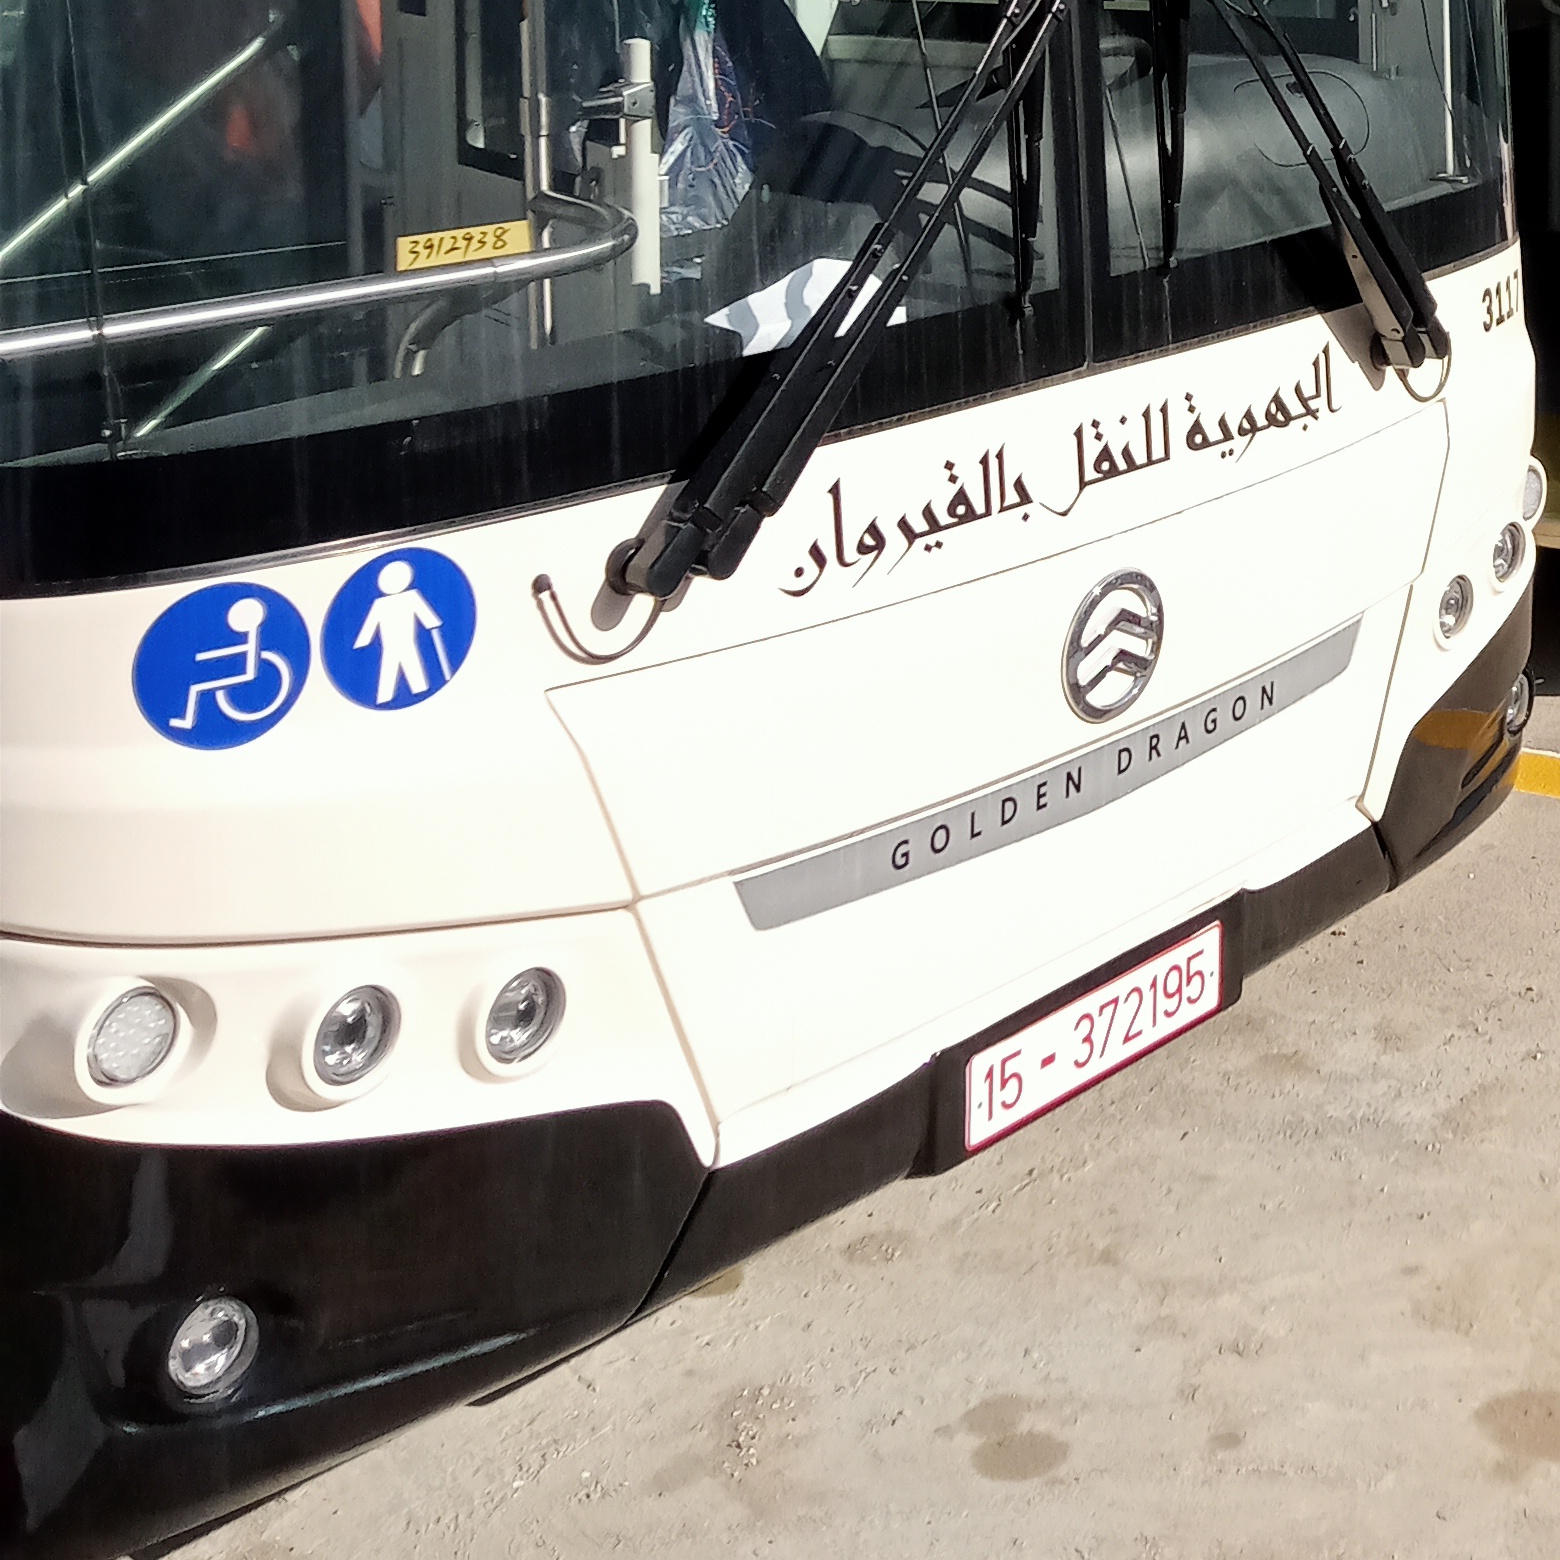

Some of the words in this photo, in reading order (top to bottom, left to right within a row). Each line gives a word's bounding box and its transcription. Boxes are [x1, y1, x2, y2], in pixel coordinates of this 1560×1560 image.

[408, 226, 511, 266] 3912938
[1482, 268, 1519, 332] 3117
[1040, 398, 1172, 517] للنقل
[1185, 341, 1342, 463] الجهوية
[778, 442, 1034, 597] بالقيروان
[891, 766, 1083, 870] GOLDEN
[1116, 680, 1275, 775] DRAGON
